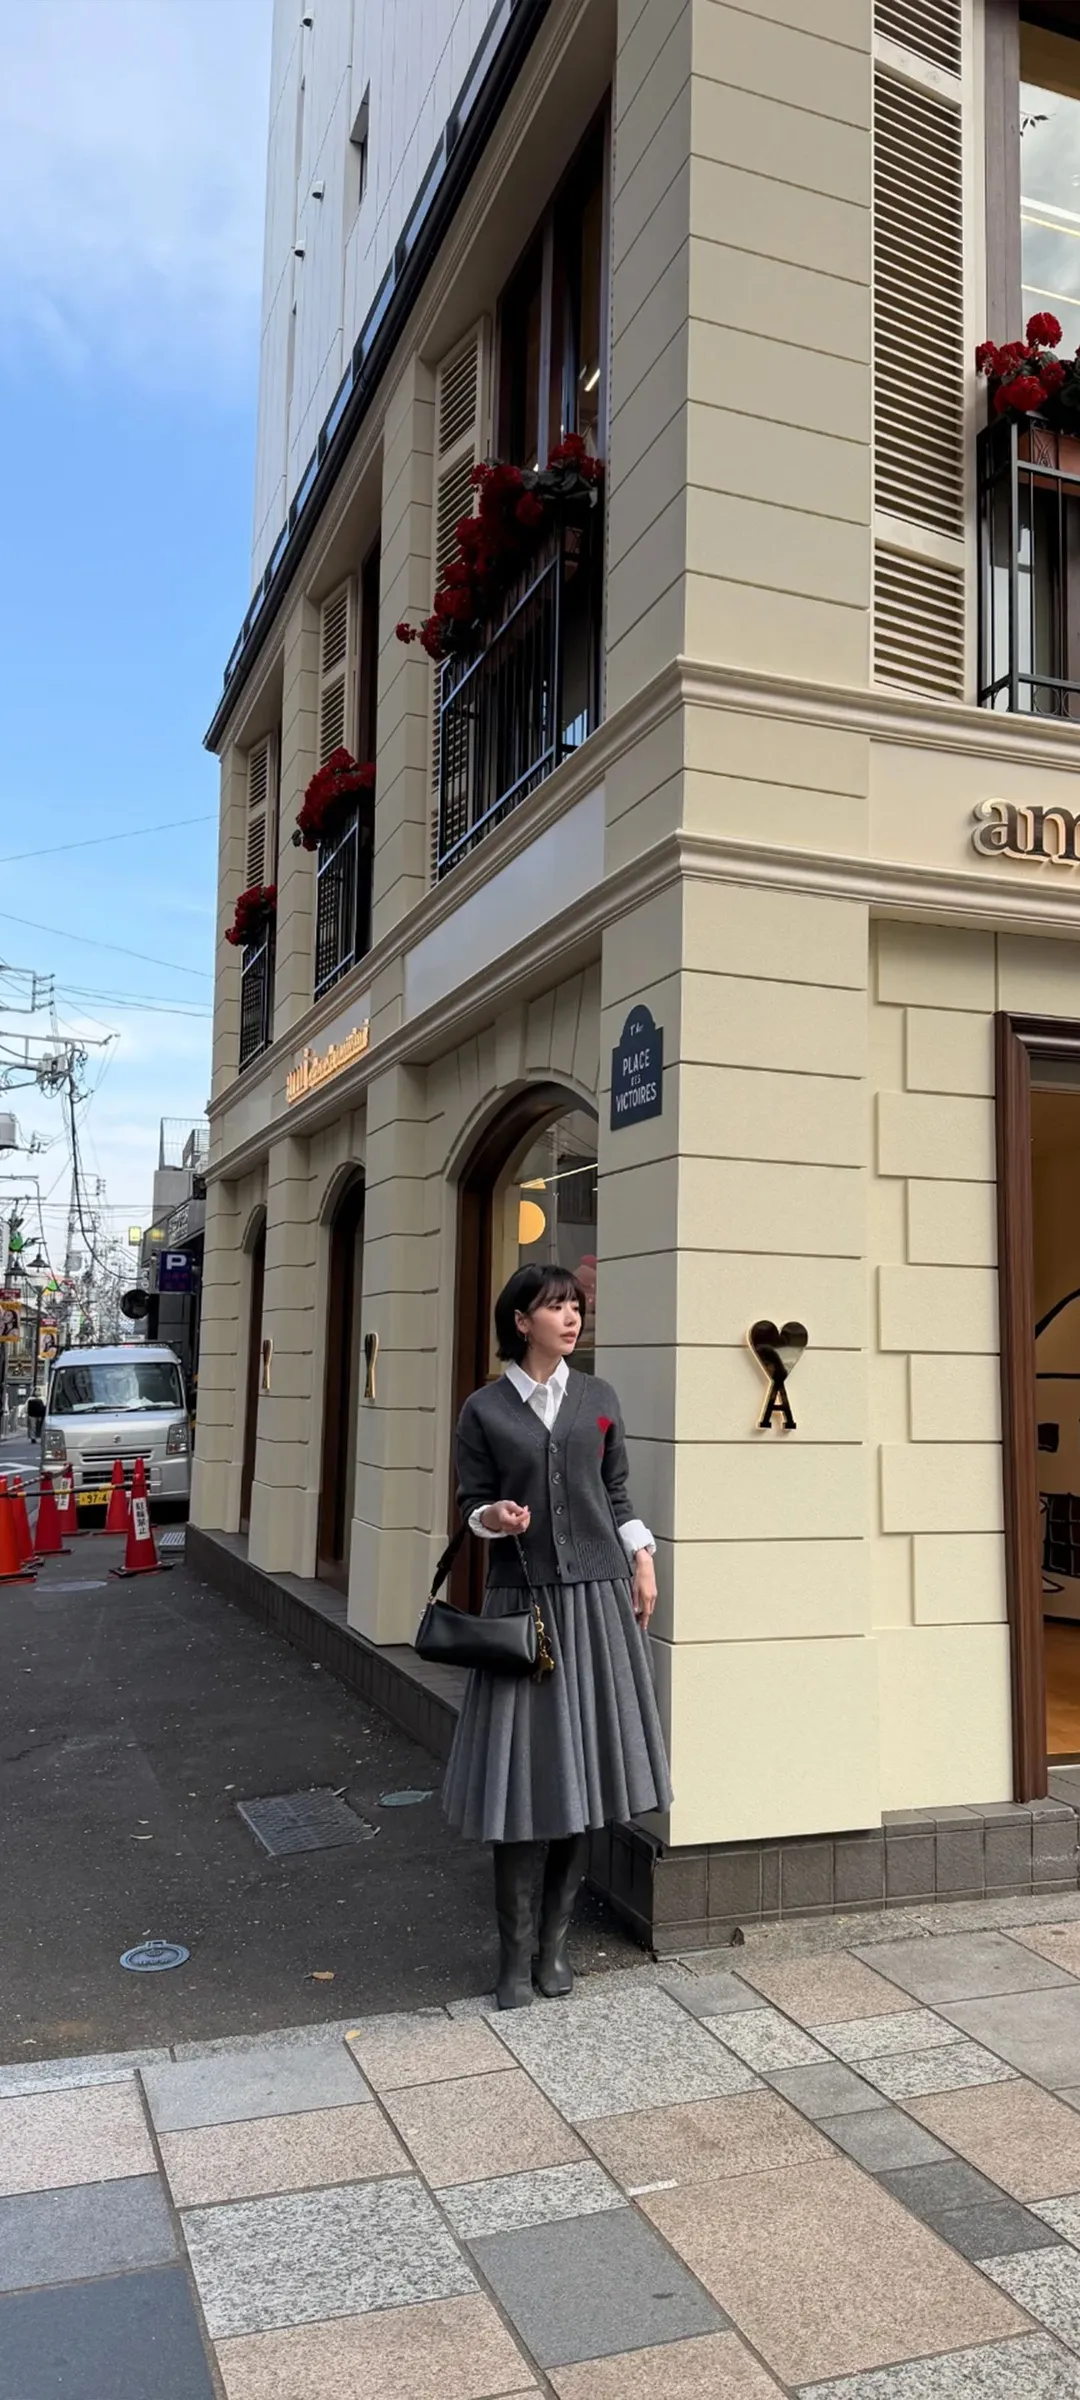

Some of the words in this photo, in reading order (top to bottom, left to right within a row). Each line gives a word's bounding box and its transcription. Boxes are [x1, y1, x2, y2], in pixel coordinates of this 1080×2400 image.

[622, 1048, 651, 1077] PLACE
[631, 1074, 641, 1086] DES
[615, 1082, 657, 1113] VICTOIRES
[166, 1254, 187, 1270] P
[87, 1493, 108, 1504] 97-4
